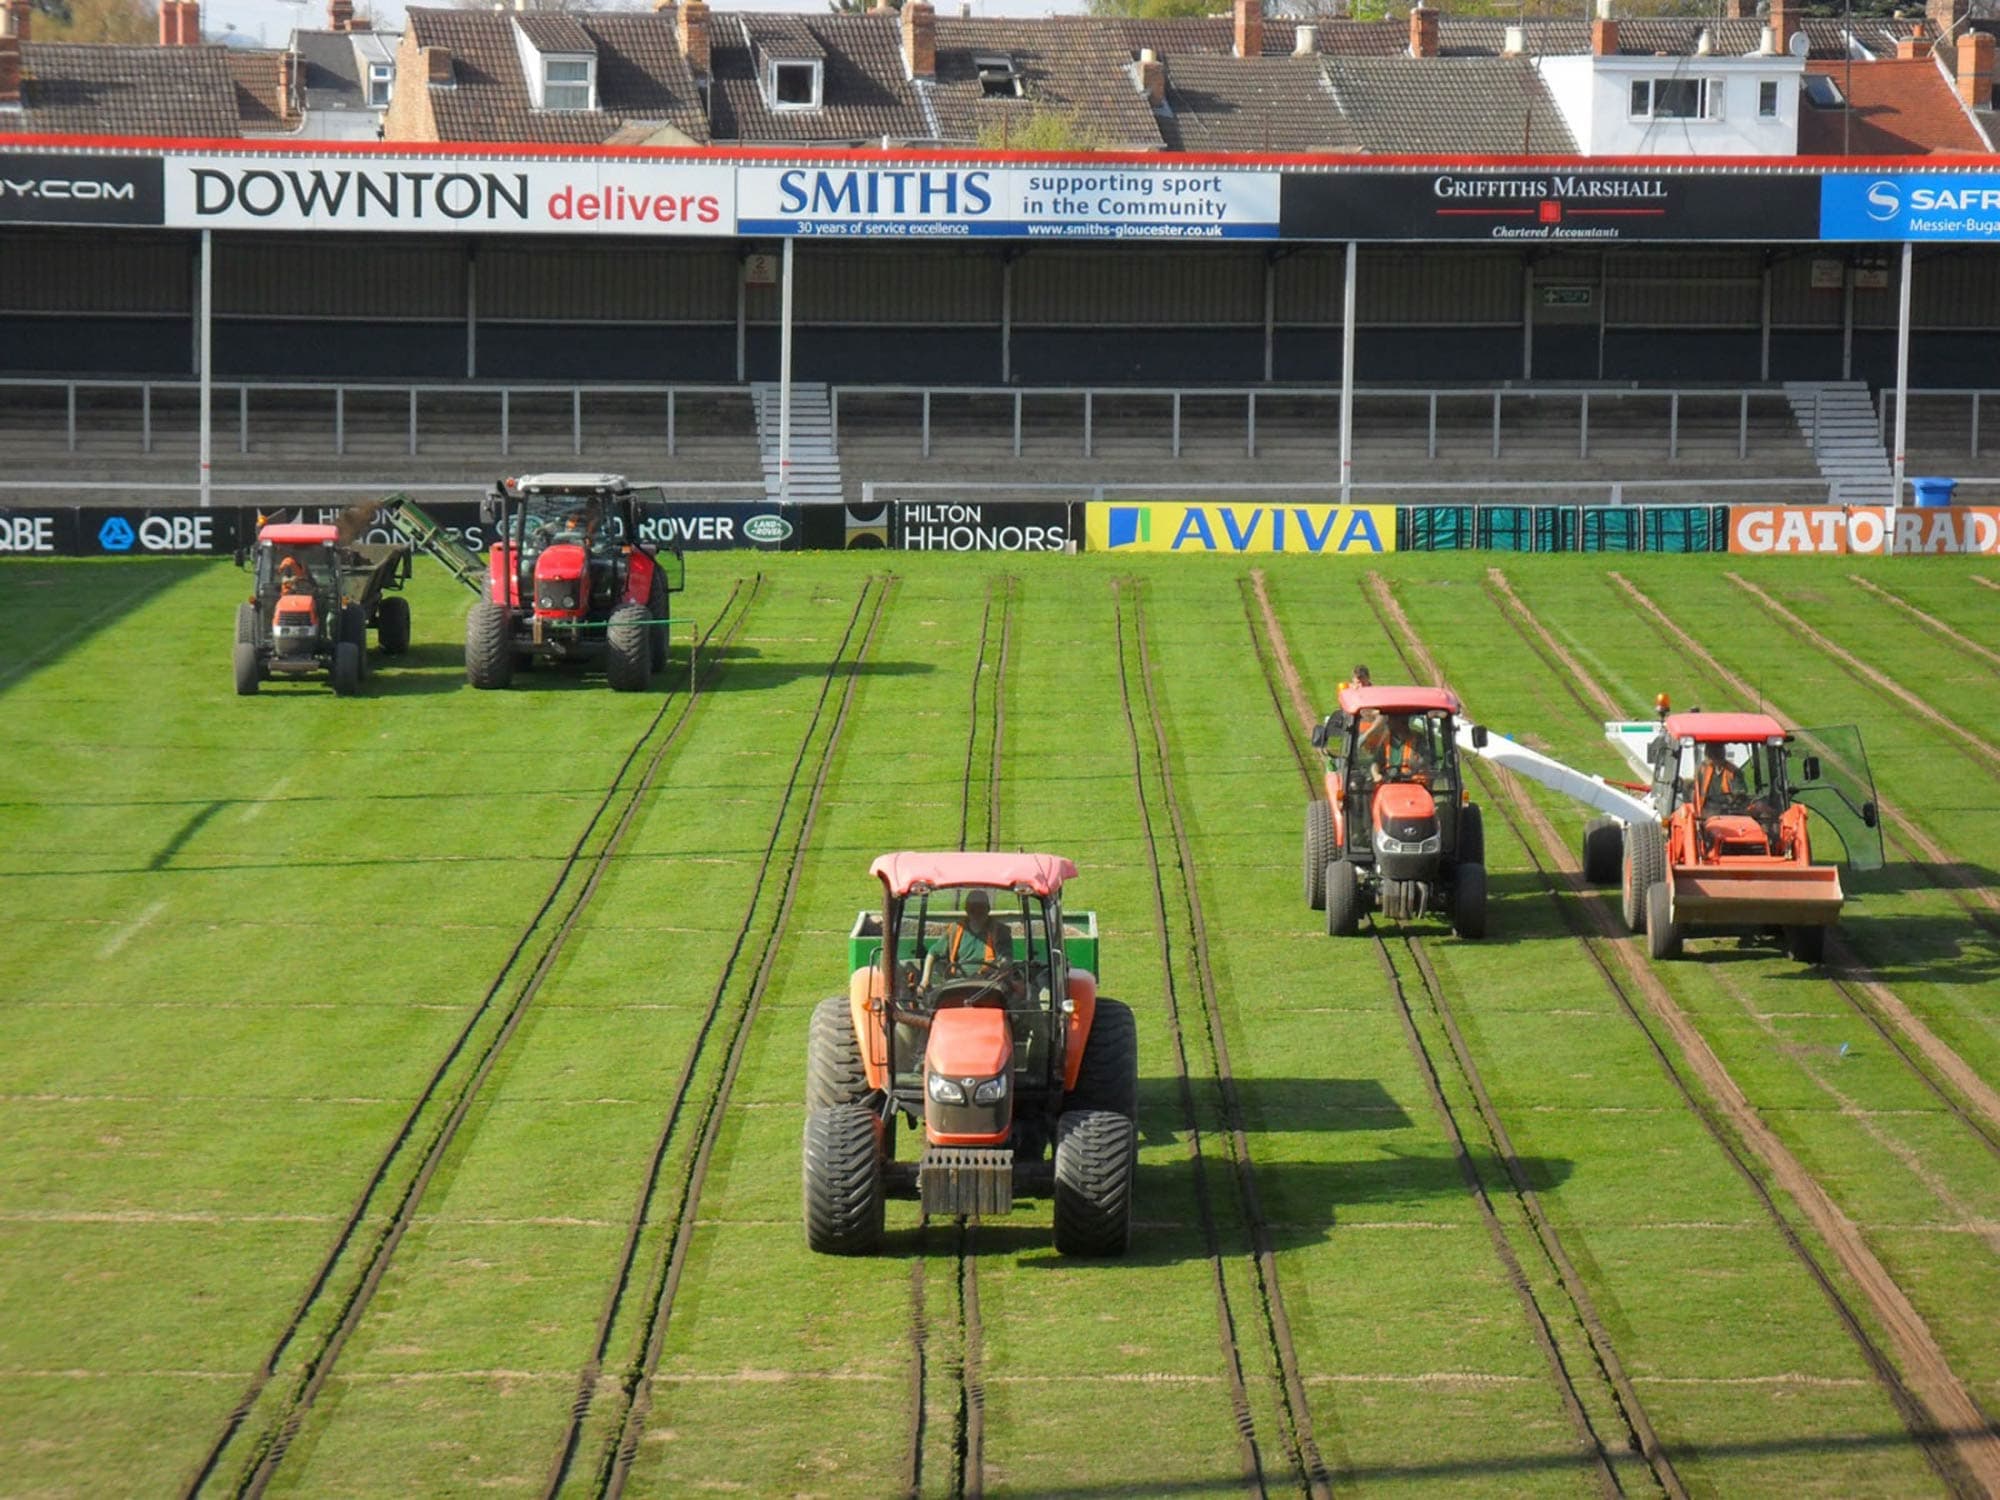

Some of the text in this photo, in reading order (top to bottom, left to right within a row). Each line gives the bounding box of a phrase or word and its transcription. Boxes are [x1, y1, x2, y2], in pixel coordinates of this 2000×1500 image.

[0, 179, 135, 200] Y.COM
[190, 168, 720, 223] DOWNTON delivers
[779, 169, 992, 215] SMITHS
[1029, 174, 1222, 196] supporting sport
[1023, 197, 1227, 219] in the Community
[797, 221, 970, 235] 30 years of service excellence
[1028, 223, 1223, 238] www.smiths-gloucester.co.uk
[1492, 226, 1619, 238] Chartered Accountants
[904, 505, 981, 523] HILTON
[139, 516, 213, 550] QBE
[904, 526, 1064, 551] HHONORS
[1170, 507, 1384, 552] AVIVA
[1737, 510, 2000, 552] GATORAD
